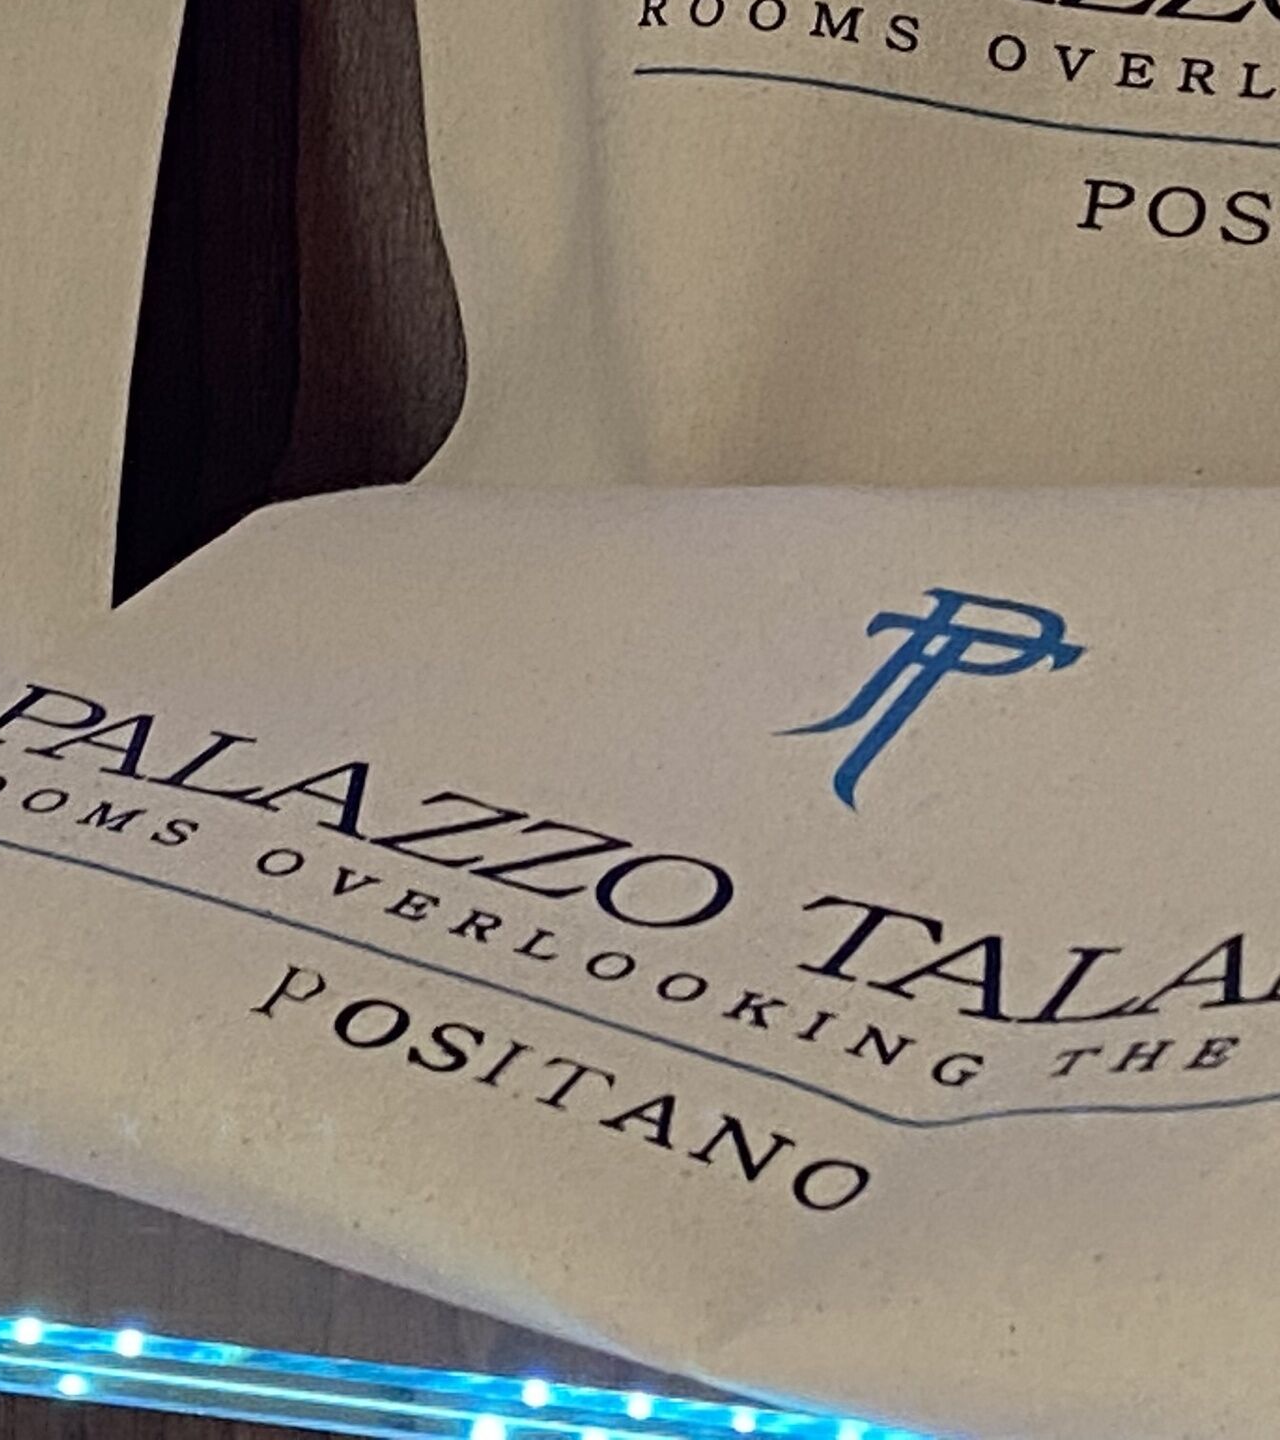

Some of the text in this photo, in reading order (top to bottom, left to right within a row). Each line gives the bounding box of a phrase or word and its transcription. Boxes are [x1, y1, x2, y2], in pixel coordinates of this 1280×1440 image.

[250, 965, 871, 1212] POSITANO
[256, 848, 985, 1088] OVERLOOKING
[1050, 1037, 1241, 1078] THE
